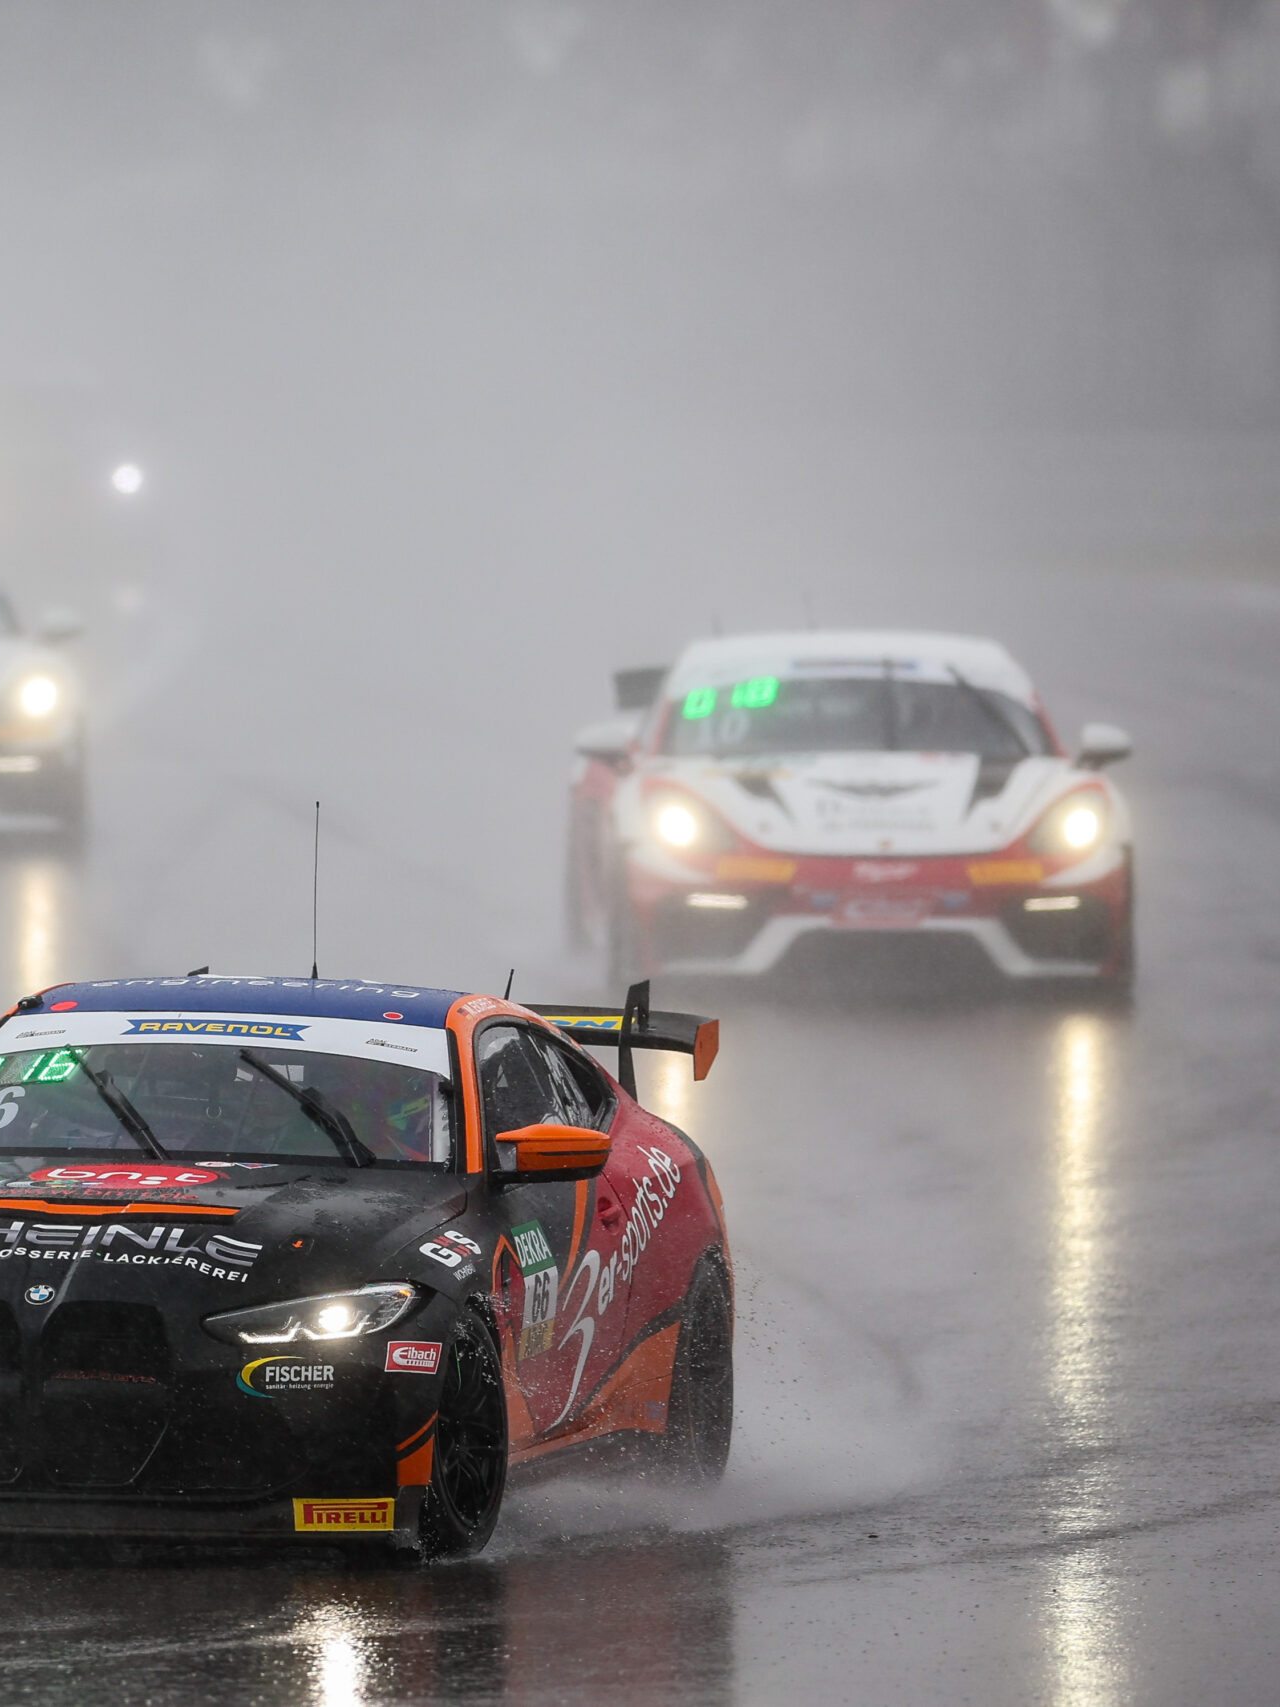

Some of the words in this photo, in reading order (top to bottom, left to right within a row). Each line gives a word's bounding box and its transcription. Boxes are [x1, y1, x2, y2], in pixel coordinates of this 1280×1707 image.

[92, 976, 421, 999] engineering
[139, 1021, 292, 1037] RAVENOL
[22, 1049, 83, 1081] 16
[513, 1227, 553, 1268] DEKRA
[103, 1252, 249, 1283] LACKIEREREI
[531, 1271, 551, 1323] 66
[392, 1346, 437, 1366] Eibach
[265, 1365, 335, 1382] FISCHER
[303, 1502, 389, 1525] PIRELLI
